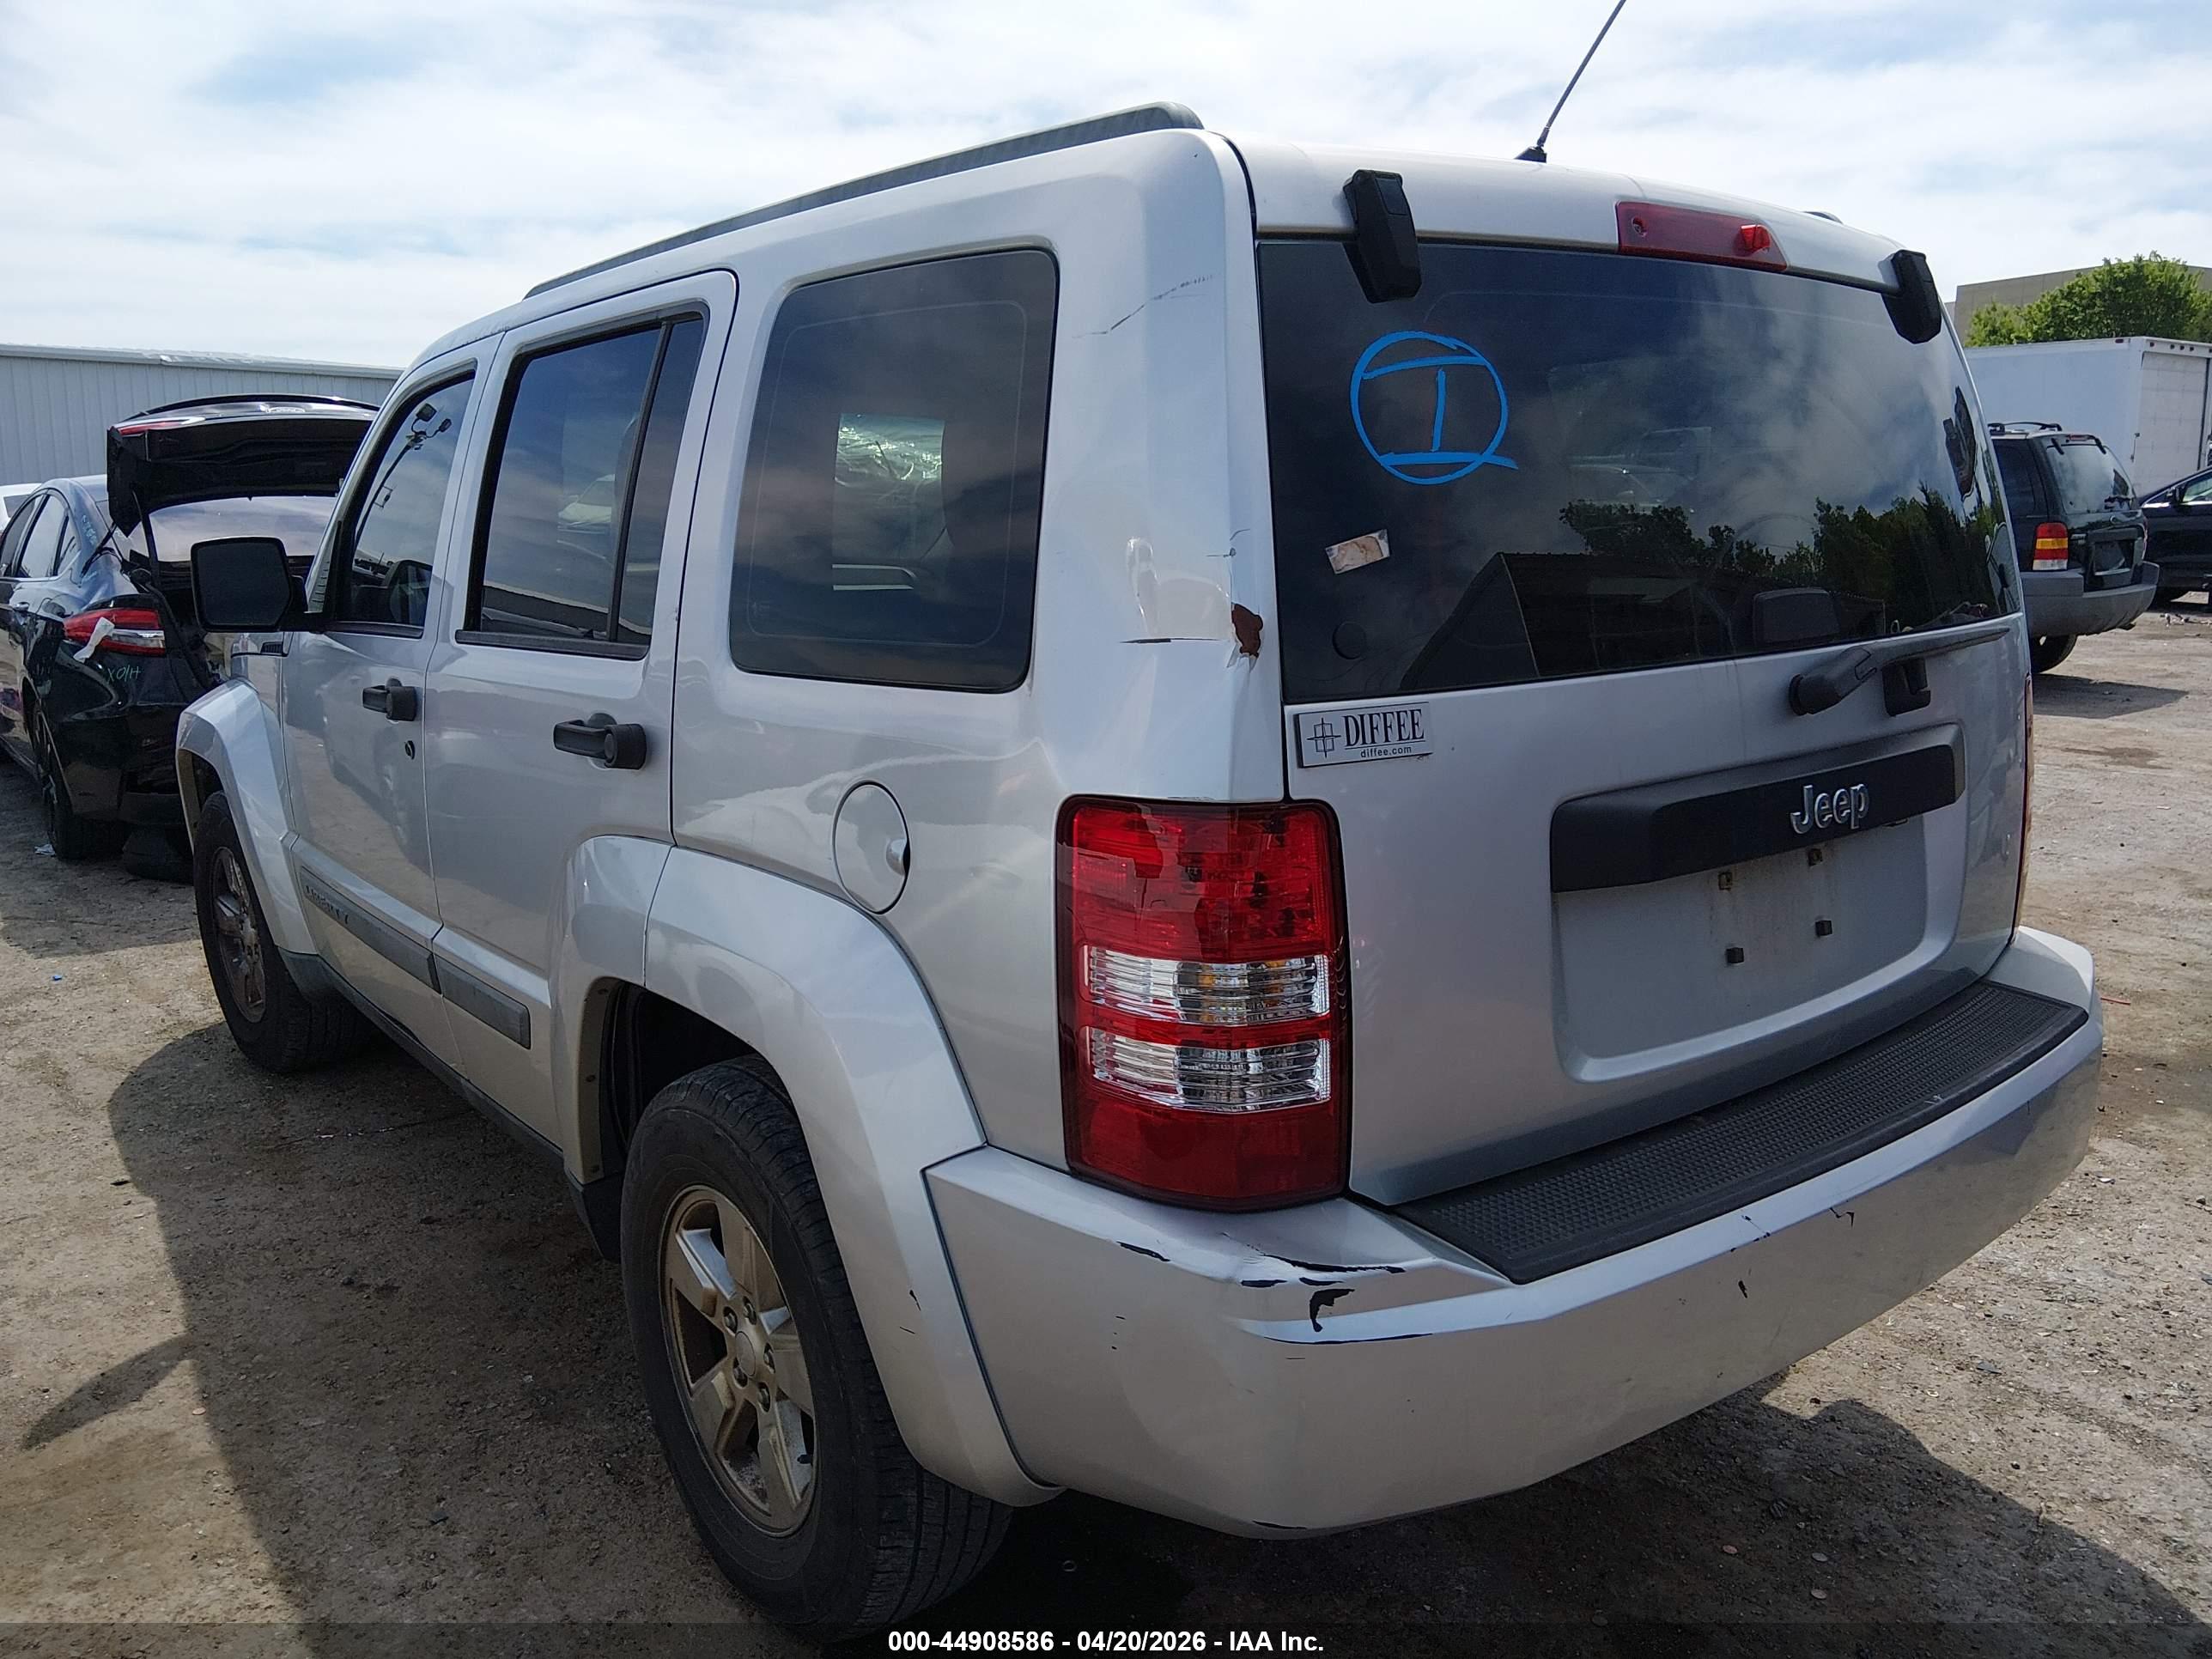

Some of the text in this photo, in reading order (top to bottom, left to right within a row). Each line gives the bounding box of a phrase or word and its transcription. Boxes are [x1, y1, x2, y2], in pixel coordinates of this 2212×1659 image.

[1342, 708, 1425, 747] DIFFEE
[1360, 745, 1412, 758] diffee.com
[1790, 783, 1869, 835] Jeep
